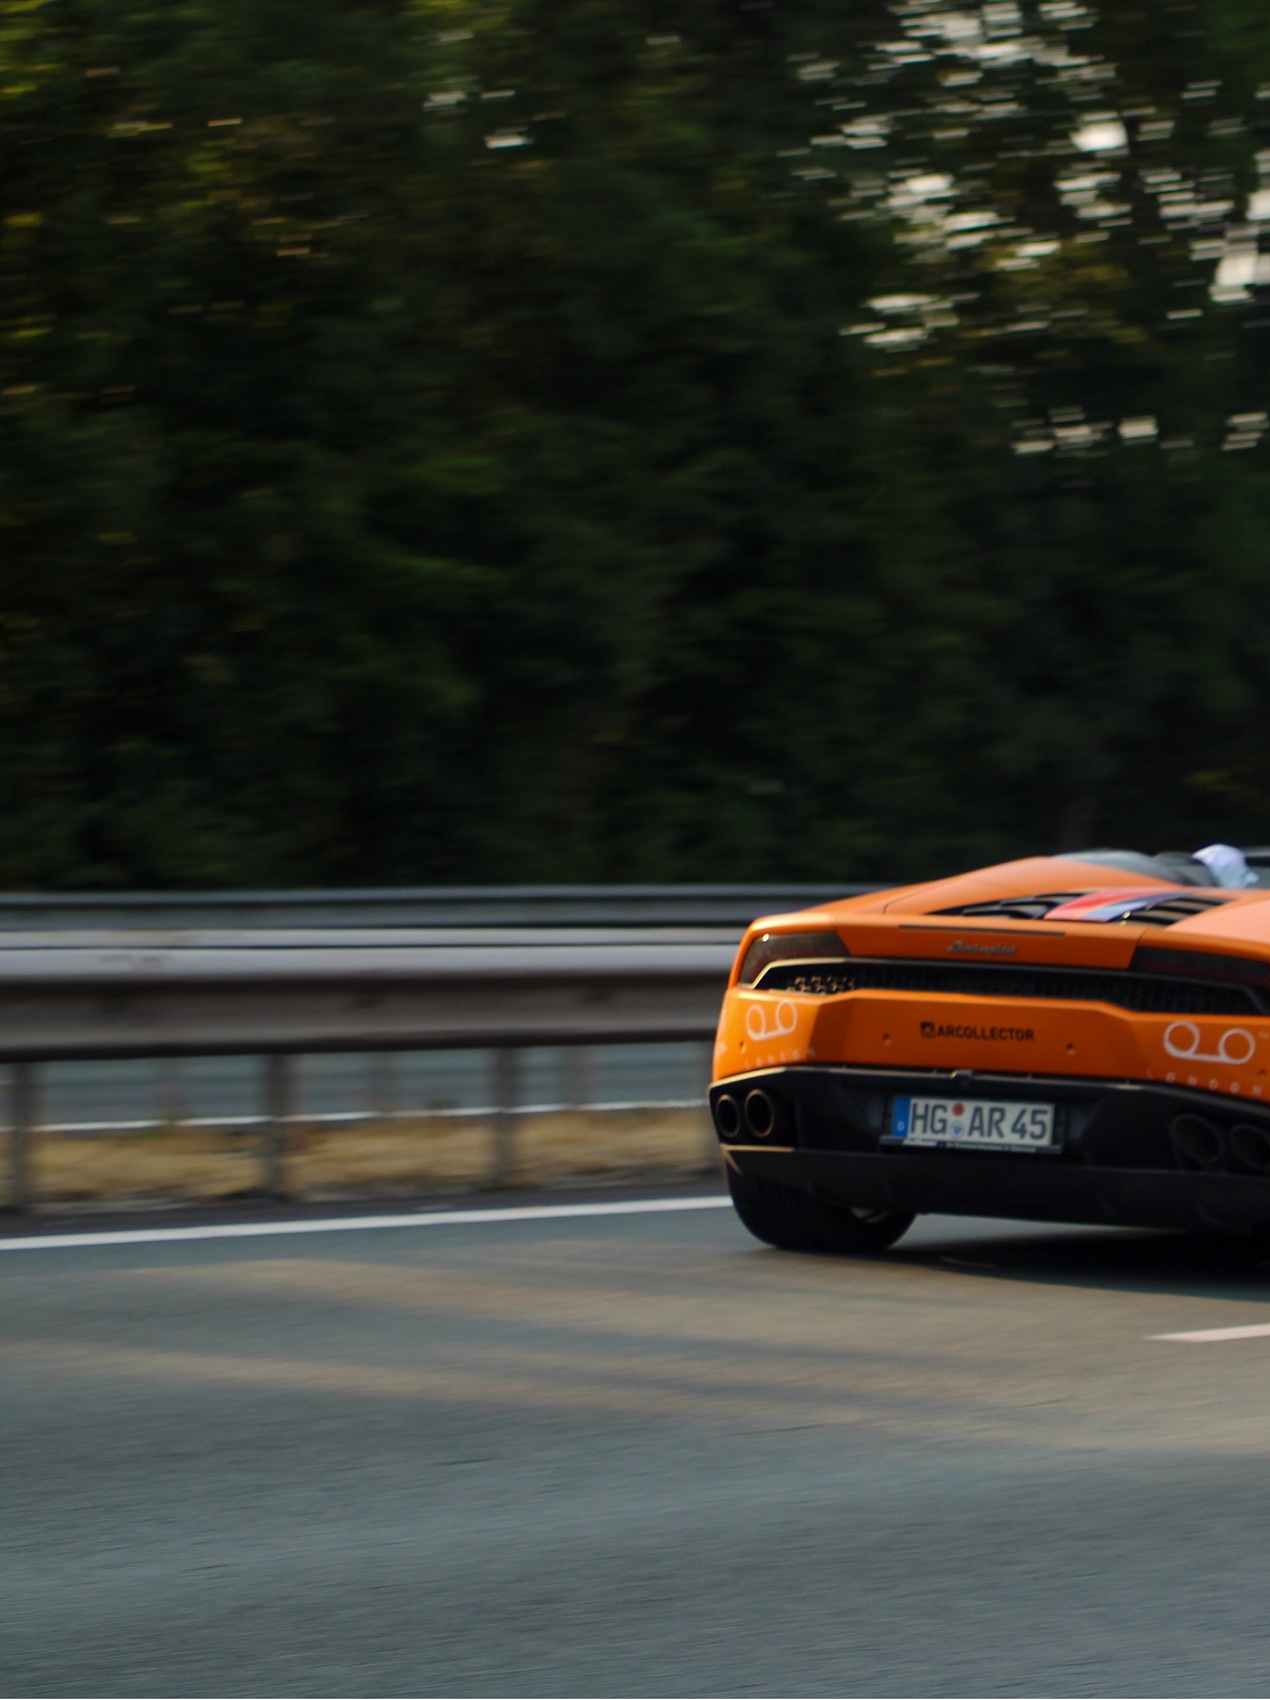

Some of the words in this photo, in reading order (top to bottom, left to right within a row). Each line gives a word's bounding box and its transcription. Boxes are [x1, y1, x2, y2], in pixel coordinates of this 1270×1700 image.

[910, 1103, 948, 1135] HG
[967, 1106, 1006, 1138] AR
[1010, 1108, 1049, 1141] 45
